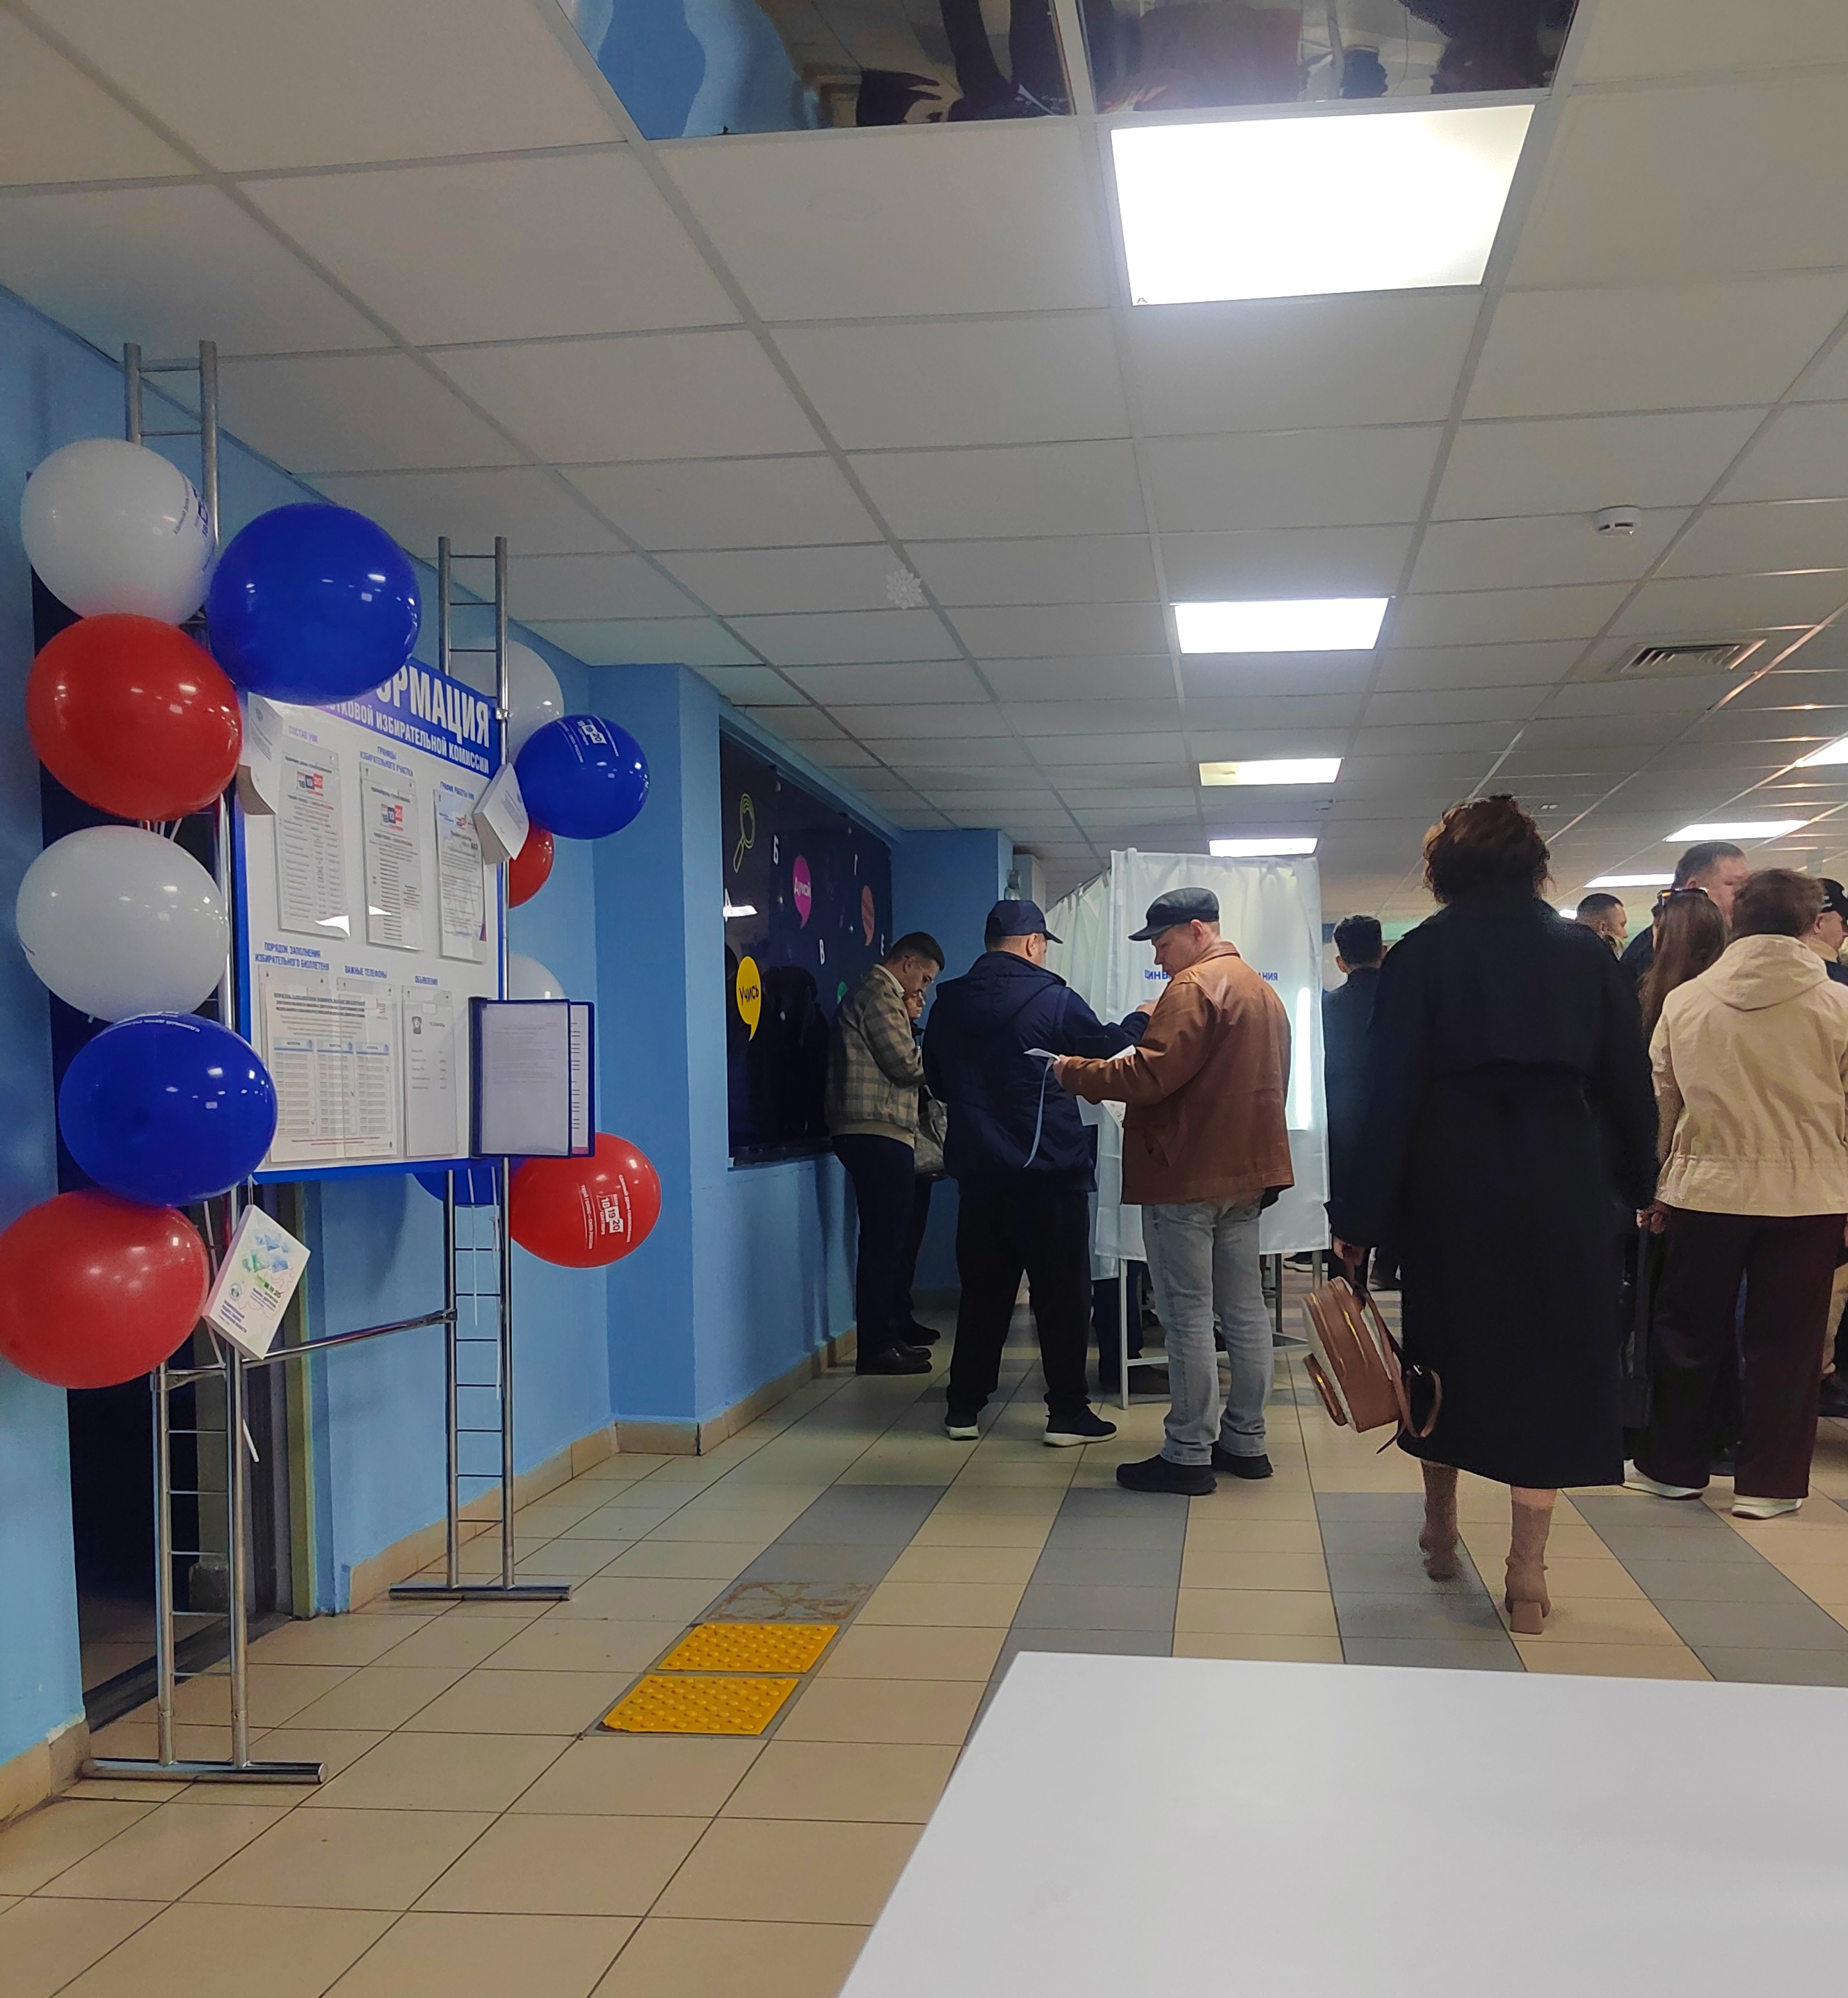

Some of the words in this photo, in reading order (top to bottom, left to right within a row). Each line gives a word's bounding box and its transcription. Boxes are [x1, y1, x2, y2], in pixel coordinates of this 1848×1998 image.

[376, 711, 447, 756] ИЗБИРАТЕЛЬНОЙ
[448, 743, 490, 775] КОМИССИИ
[592, 732, 602, 742] 20
[314, 776, 322, 786] 20
[773, 835, 780, 865] Б
[819, 939, 826, 965] В
[255, 953, 300, 967] ИЗБИРАТЕЛЬНОГО
[601, 1197, 610, 1209] 18
[608, 1208, 616, 1218] 19
[613, 1219, 620, 1231] 20
